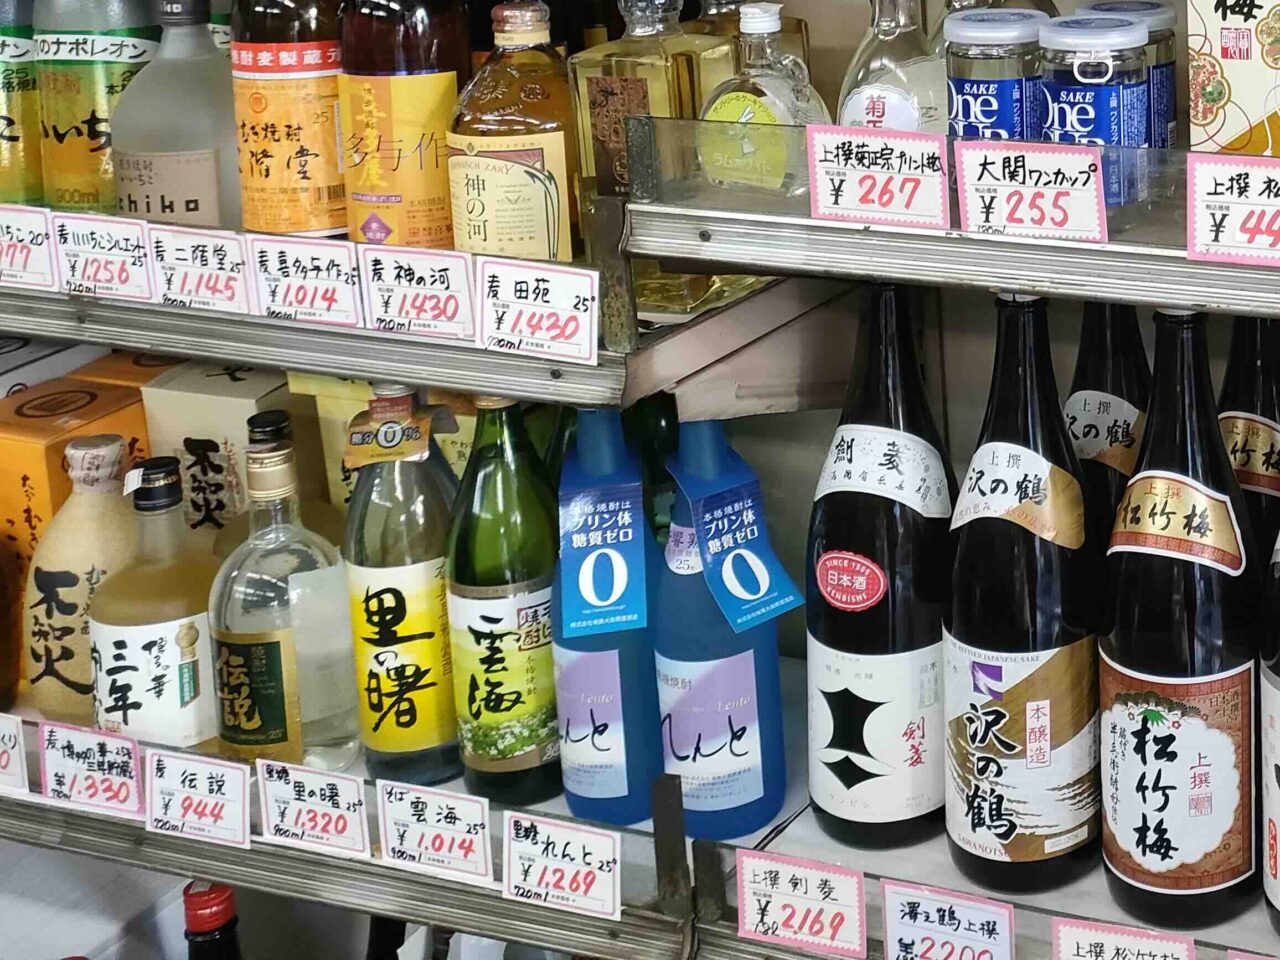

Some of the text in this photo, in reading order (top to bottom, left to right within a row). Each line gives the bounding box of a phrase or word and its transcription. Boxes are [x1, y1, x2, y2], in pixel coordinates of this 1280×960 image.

[964, 83, 998, 94] SAKE
[1060, 91, 1094, 102] SAKE
[1206, 172, 1251, 199] 上撰
[464, 173, 488, 242] 神の河
[394, 263, 450, 290] 神の河
[514, 278, 550, 304] 田苑
[968, 467, 1047, 506] 沢の鶴
[573, 514, 633, 531] プリン体
[704, 510, 756, 539] プリン体
[1121, 496, 1214, 539] 松竹梅
[571, 529, 633, 548] 糖質ゼロ
[708, 525, 759, 555] 糖質ゼロ
[578, 548, 628, 607] 0
[721, 548, 770, 601] 0
[828, 570, 867, 590] 日本酒
[30, 566, 95, 695] 不知火
[361, 586, 437, 733] 里の曙
[467, 615, 526, 721] 雲海
[105, 639, 143, 726] 三年
[216, 646, 263, 731] 伝説
[1028, 704, 1048, 764] 本醸造
[180, 770, 226, 796] 伝説
[963, 703, 1022, 843] 沢の鶴
[1189, 752, 1212, 788] 上撰
[1130, 715, 1179, 862] 松竹梅
[410, 797, 462, 826] 雲海
[541, 835, 593, 865] れんと
[749, 869, 780, 890] 上撰
